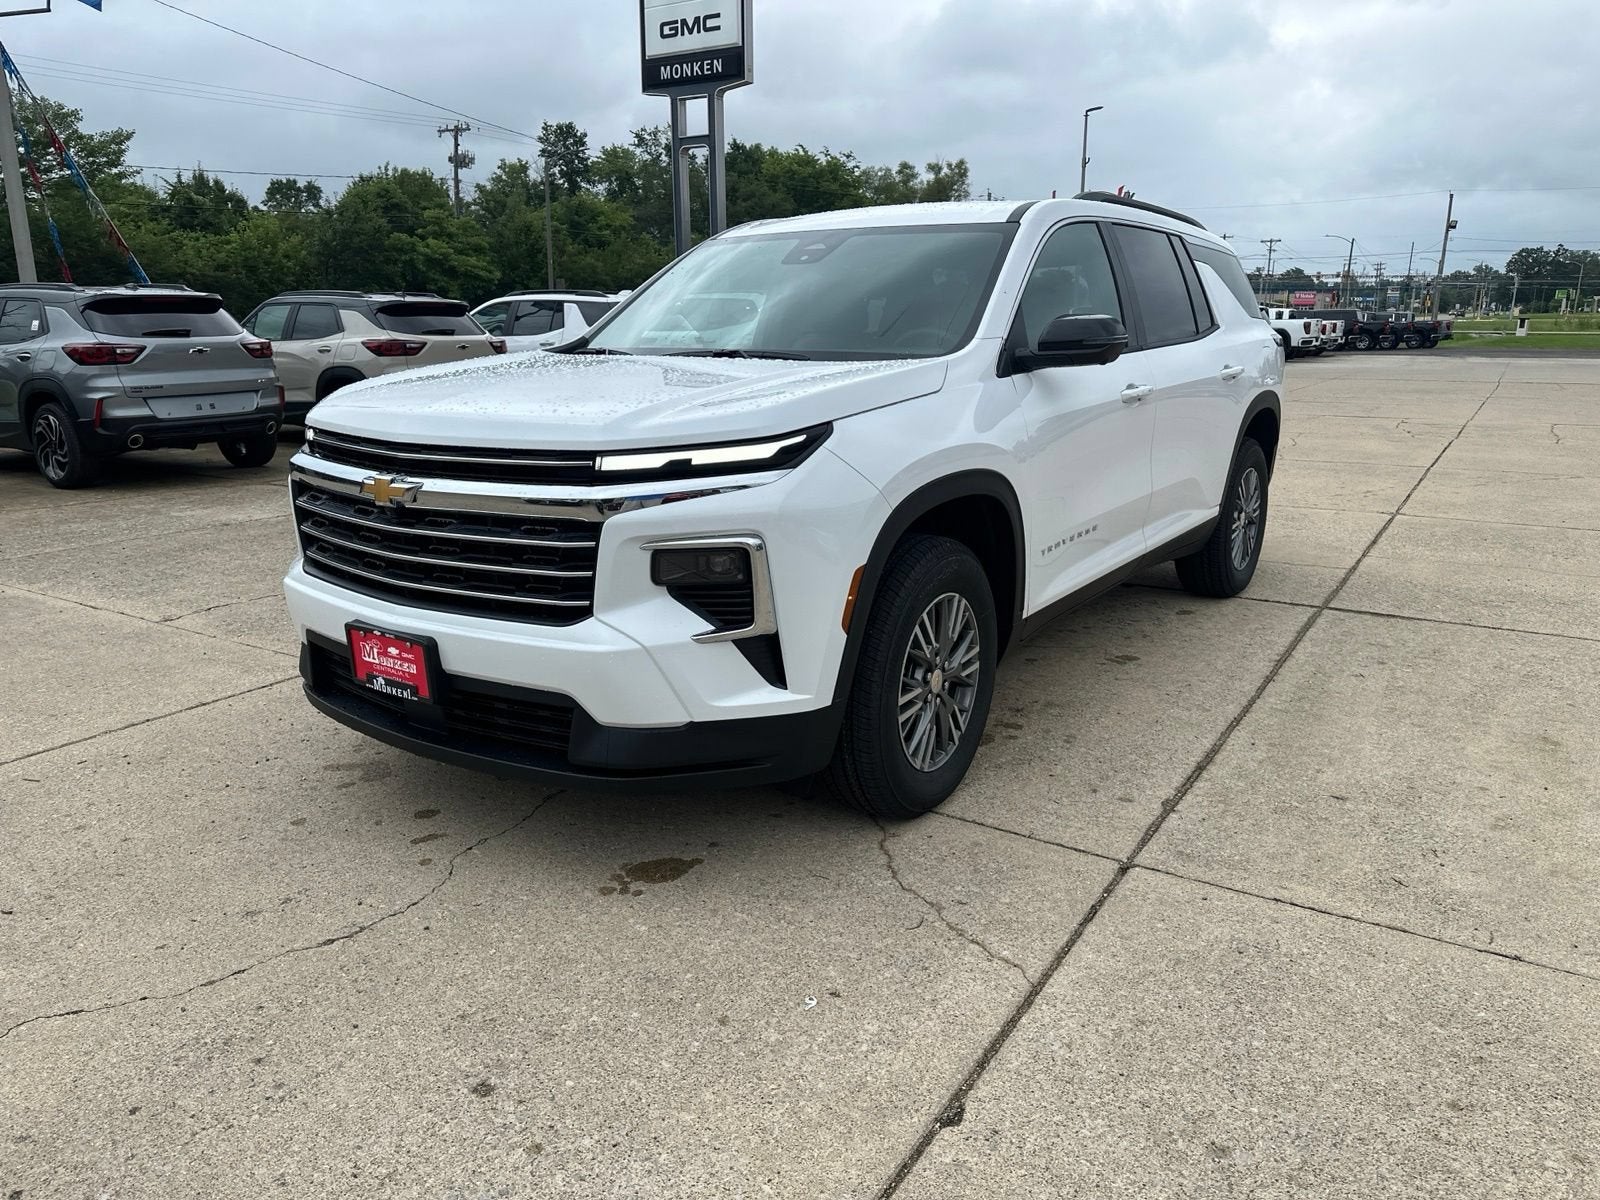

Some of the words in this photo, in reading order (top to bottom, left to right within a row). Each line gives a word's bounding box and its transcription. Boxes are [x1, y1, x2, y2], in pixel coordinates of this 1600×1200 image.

[660, 13, 721, 39] GMC
[660, 59, 722, 80] MONKEN
[1041, 523, 1098, 556] TRAVERSE
